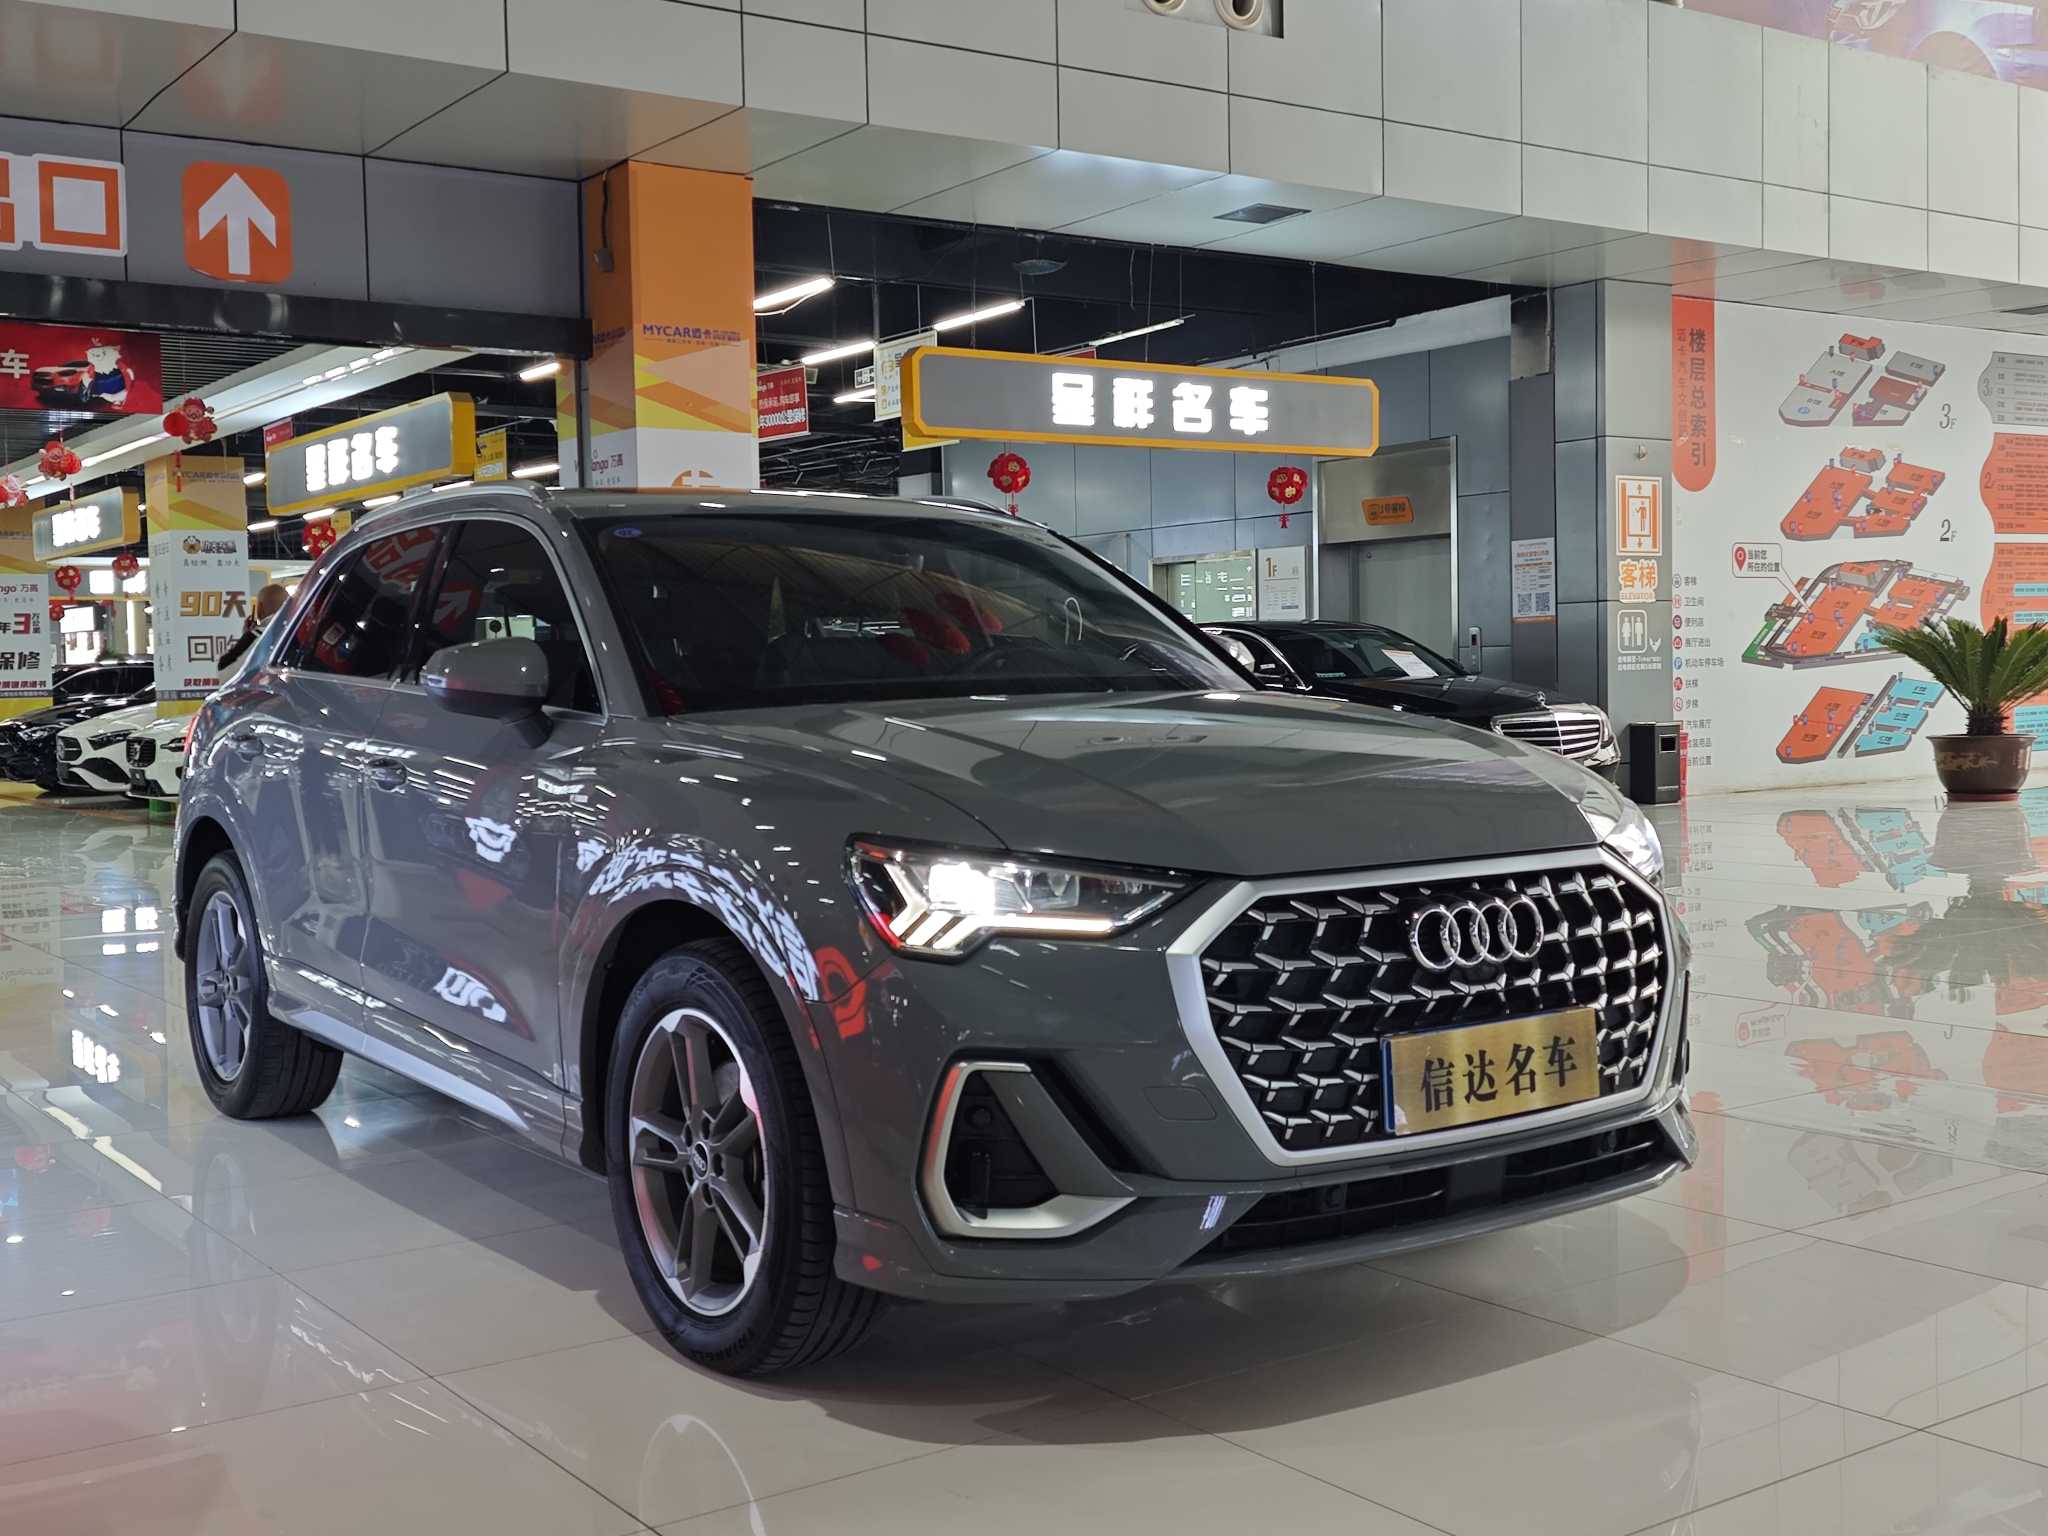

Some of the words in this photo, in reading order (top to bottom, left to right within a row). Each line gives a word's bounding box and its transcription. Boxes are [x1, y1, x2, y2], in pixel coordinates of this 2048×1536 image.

[0, 157, 121, 250] 口
[1689, 328, 1706, 466] 楼层总索引
[180, 591, 247, 618] 90天
[1620, 562, 1656, 588] 客梯
[1420, 1036, 1577, 1113] 信达名车
